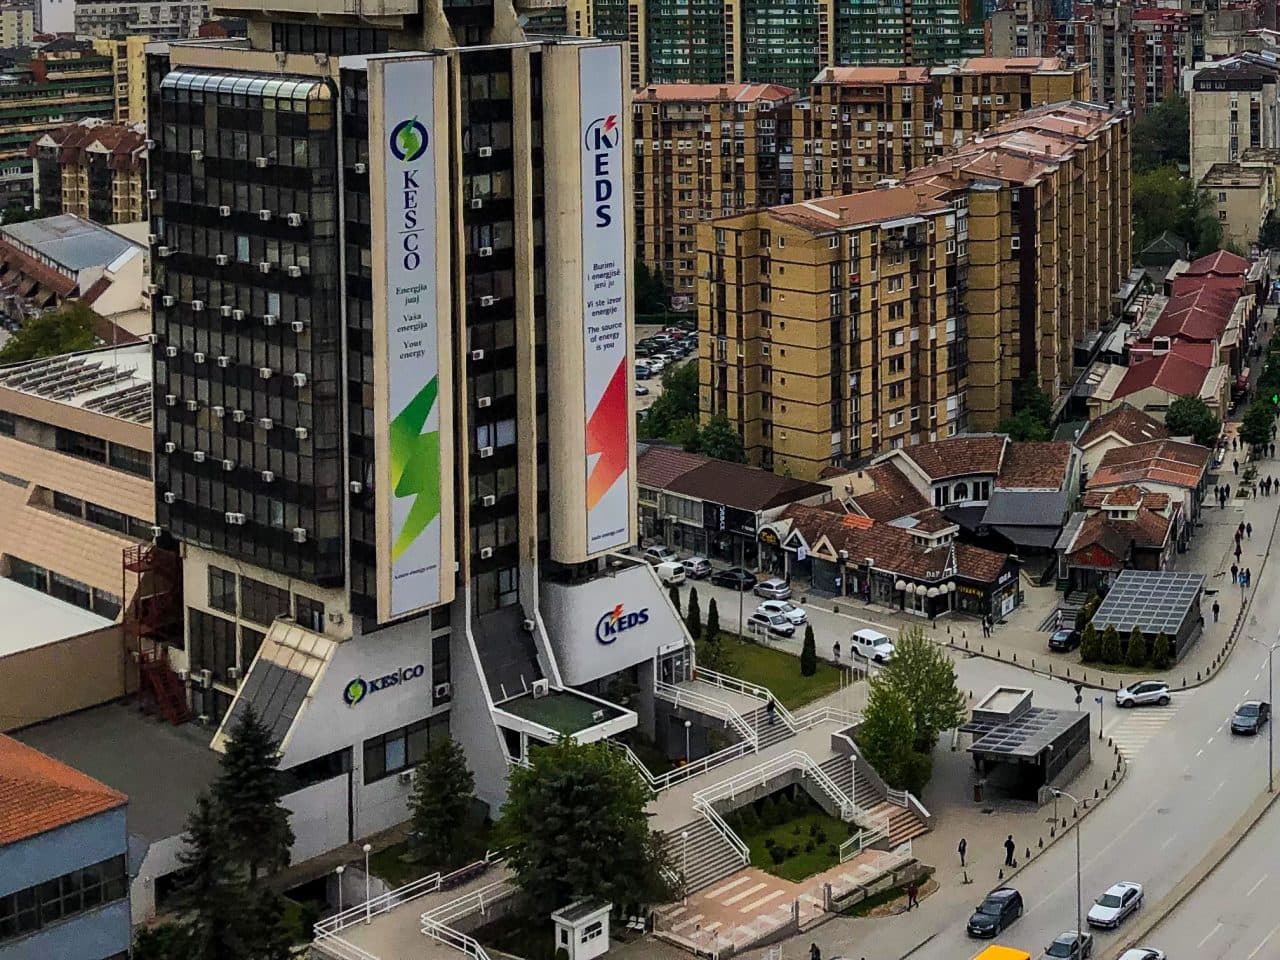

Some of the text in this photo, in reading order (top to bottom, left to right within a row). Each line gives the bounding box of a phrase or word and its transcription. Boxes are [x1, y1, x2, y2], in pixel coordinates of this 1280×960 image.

[594, 118, 615, 228] KEDS
[588, 321, 623, 335] The source
[599, 331, 620, 342] energy
[403, 340, 422, 350] Your
[603, 342, 615, 352] you
[399, 348, 425, 360] energy
[604, 605, 649, 637] KEDS
